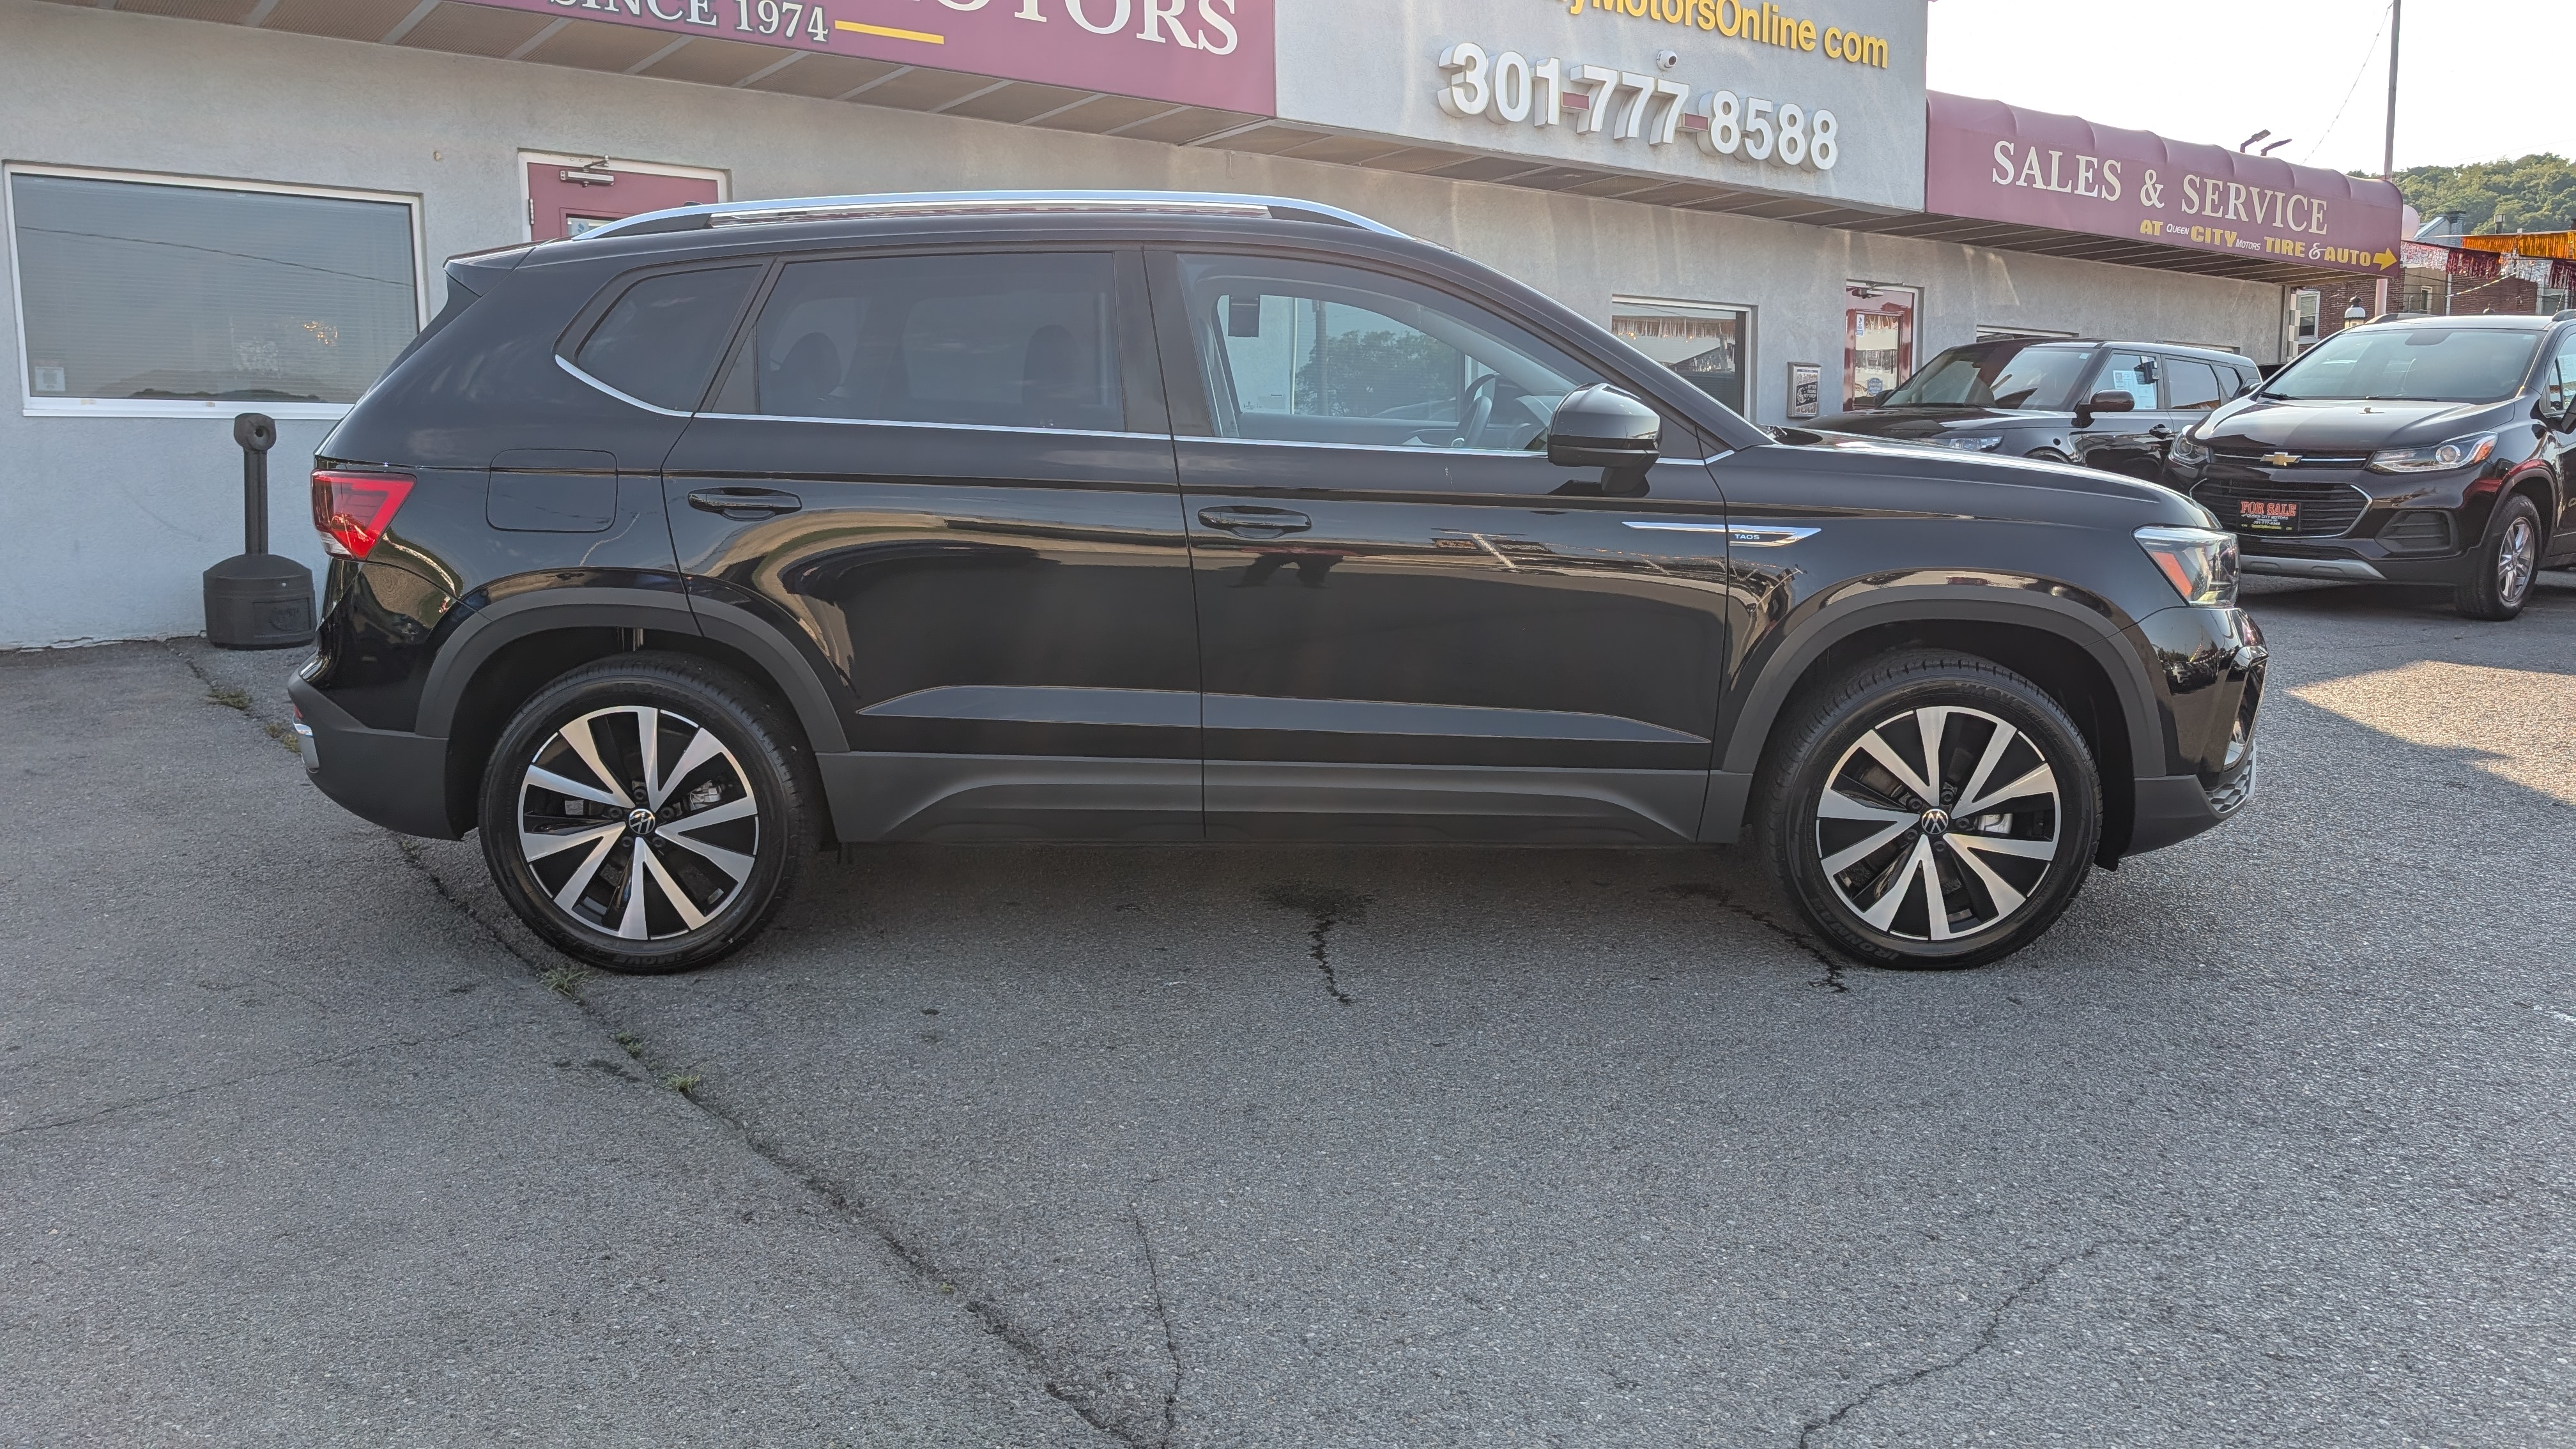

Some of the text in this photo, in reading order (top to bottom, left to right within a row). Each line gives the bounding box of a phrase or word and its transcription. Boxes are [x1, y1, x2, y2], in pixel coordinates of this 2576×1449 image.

[735, 0, 829, 42] 1974
[1560, 0, 1889, 68] otorsOnline com
[1439, 42, 1838, 171] 301-777-8588
[1992, 141, 2327, 234] SALES & SERVICE
[2140, 219, 2371, 266] AT QUEEN CITY MOTORS TIRE & AUTO
[2240, 501, 2297, 517] FOR SALE
